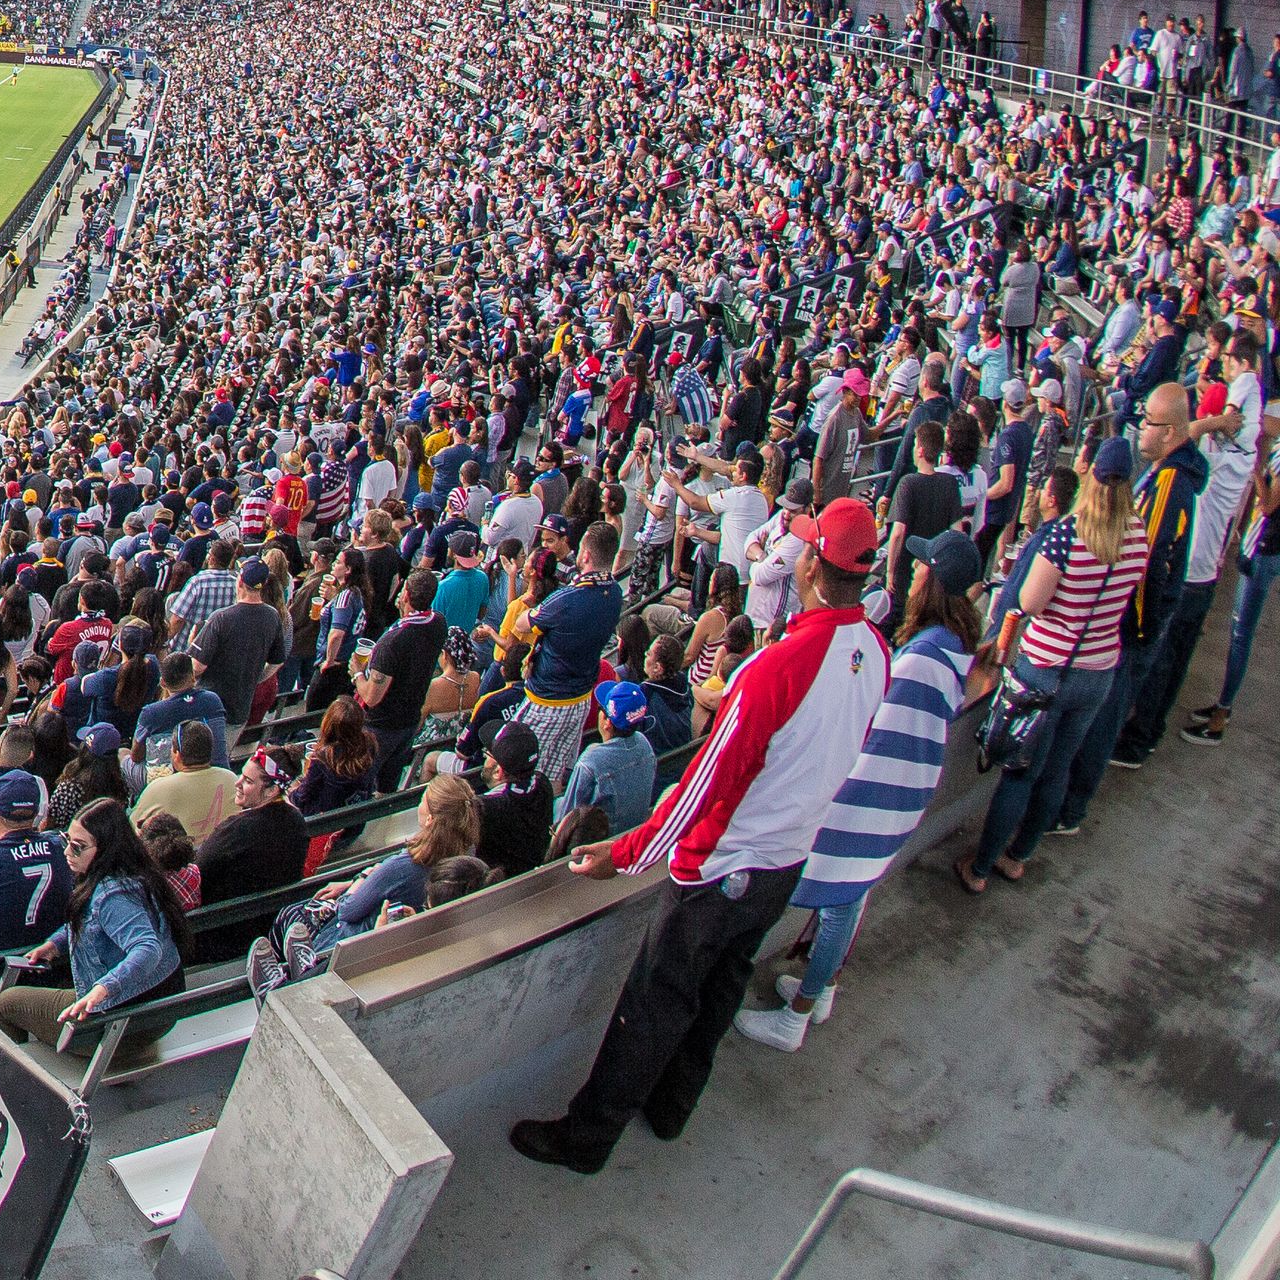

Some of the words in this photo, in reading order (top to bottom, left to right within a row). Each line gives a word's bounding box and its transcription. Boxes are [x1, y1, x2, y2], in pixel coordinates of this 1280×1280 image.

[48, 58, 77, 66] MANUEL
[289, 488, 304, 510] 10
[78, 625, 111, 641] DONOVAN
[10, 841, 51, 861] KEANE
[21, 863, 52, 926] 7
